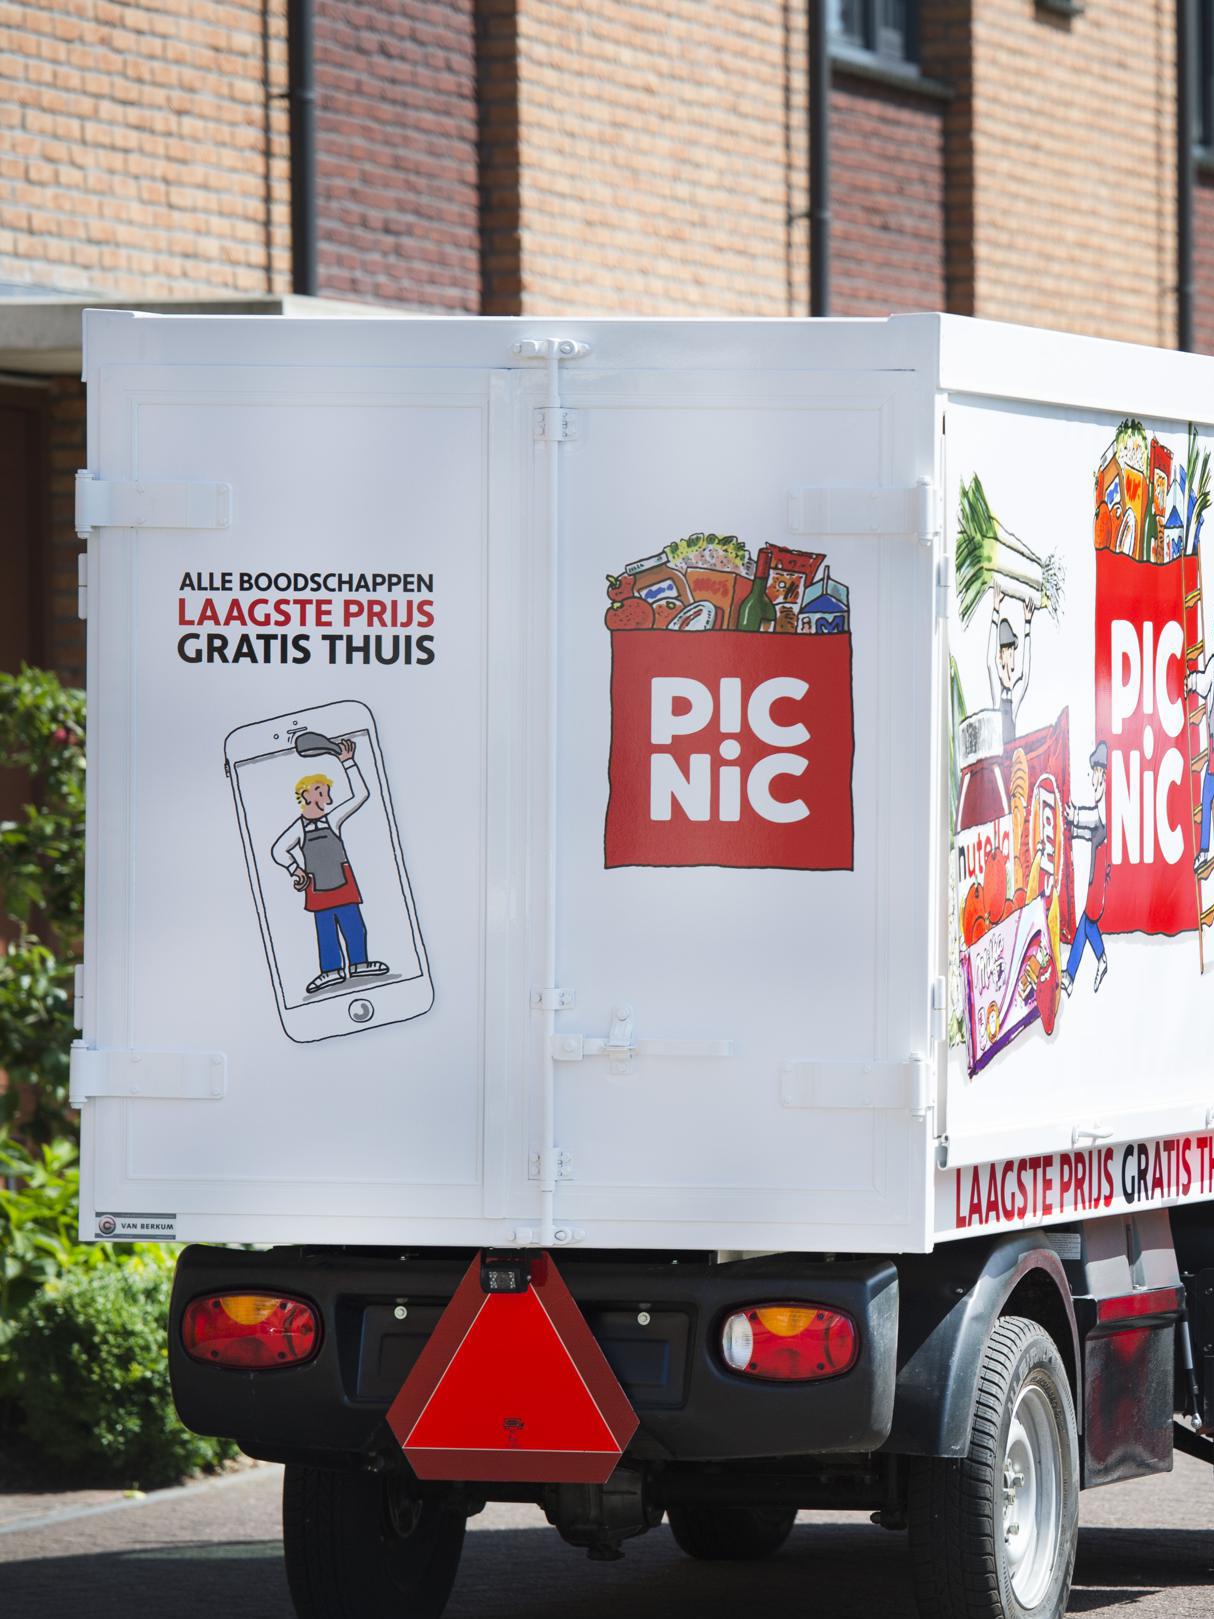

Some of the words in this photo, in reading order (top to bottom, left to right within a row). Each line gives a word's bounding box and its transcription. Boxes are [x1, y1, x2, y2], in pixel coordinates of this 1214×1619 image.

[179, 571, 233, 592] ALLE
[239, 572, 434, 593] BOODSCHAPPEN
[177, 597, 333, 627] LAAGSTE
[343, 599, 435, 629] PRIJS
[177, 633, 312, 665] GRATIS
[321, 634, 436, 666] THUIS
[1111, 619, 1184, 738] PIC
[650, 676, 811, 748] PIC
[955, 1155, 1053, 1228] LAAGSTE
[1059, 1148, 1113, 1213] PRIJS
[1121, 1137, 1191, 1204] GRATIS
